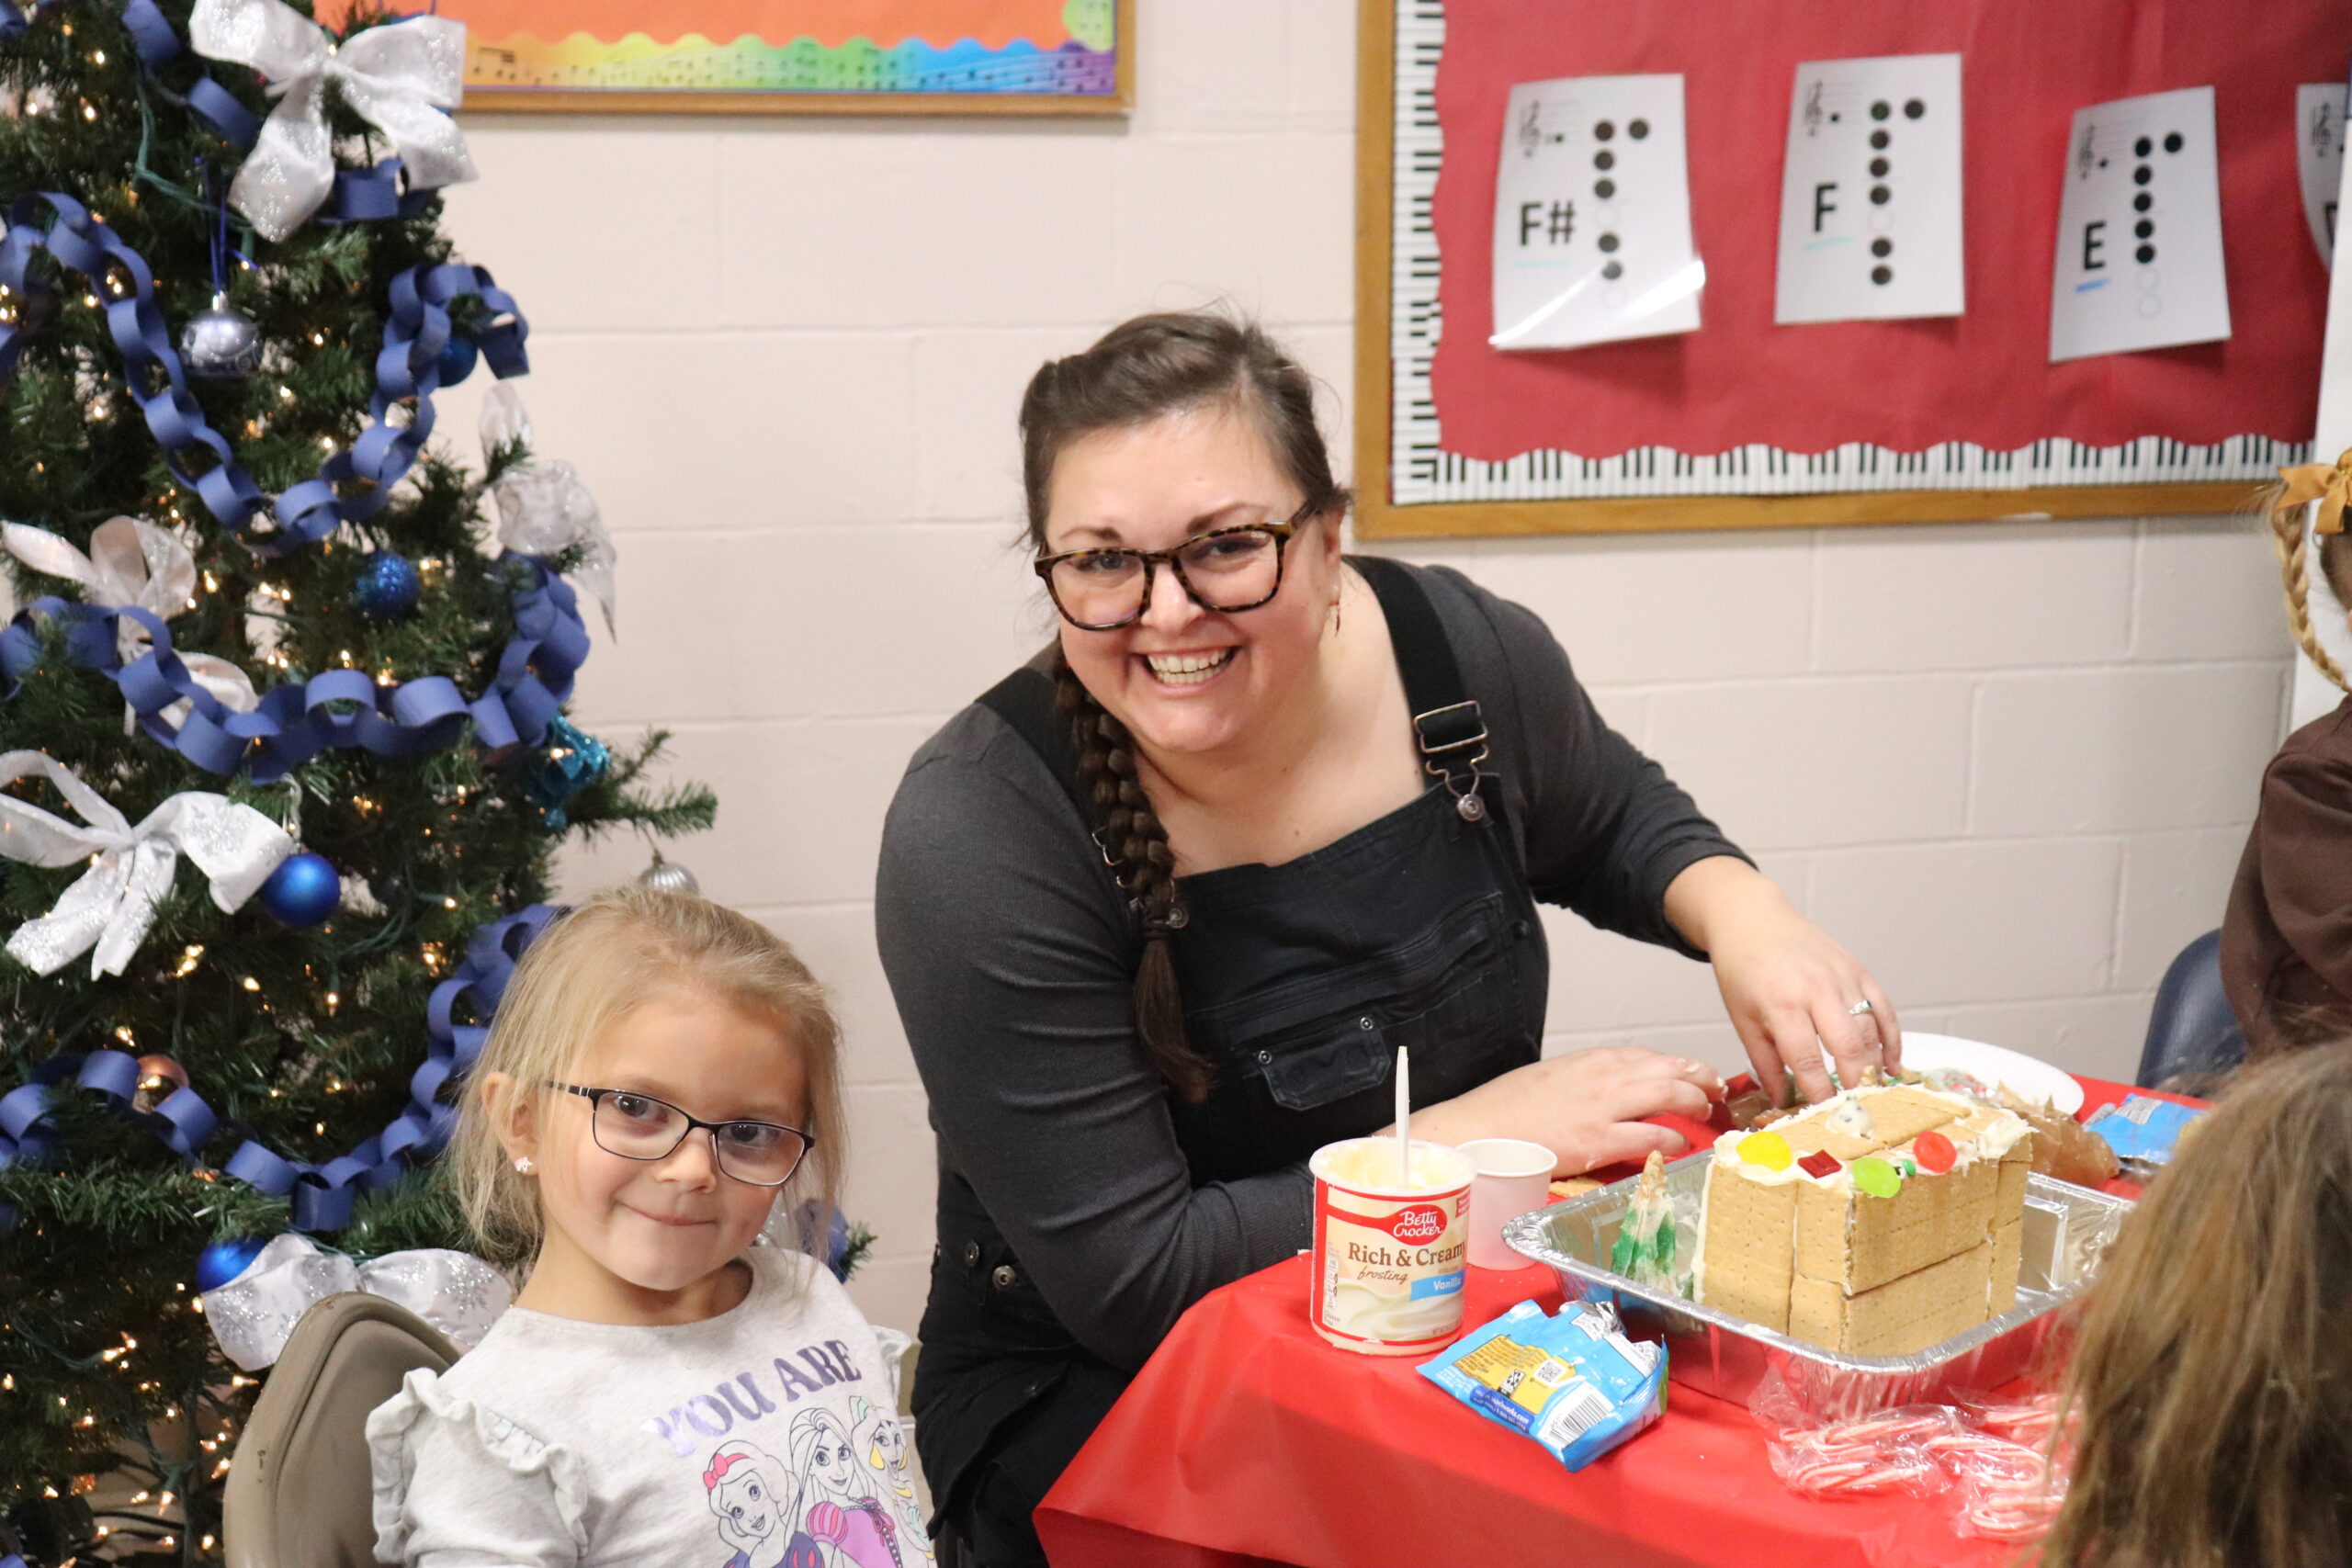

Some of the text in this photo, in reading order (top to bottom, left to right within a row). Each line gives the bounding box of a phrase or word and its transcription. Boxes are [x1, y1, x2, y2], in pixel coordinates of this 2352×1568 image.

[1813, 182, 1839, 233] F
[1519, 198, 1577, 246] F#
[2082, 220, 2107, 270] E
[1393, 1223, 1442, 1237] Crocker
[1399, 1211, 1438, 1226] Betty
[1348, 1242, 1391, 1266] Rich
[1396, 1248, 1411, 1268] &
[1357, 1265, 1408, 1285] frosting
[1433, 1277, 1462, 1292] Vanilla
[640, 1339, 862, 1458] YOU ARE
